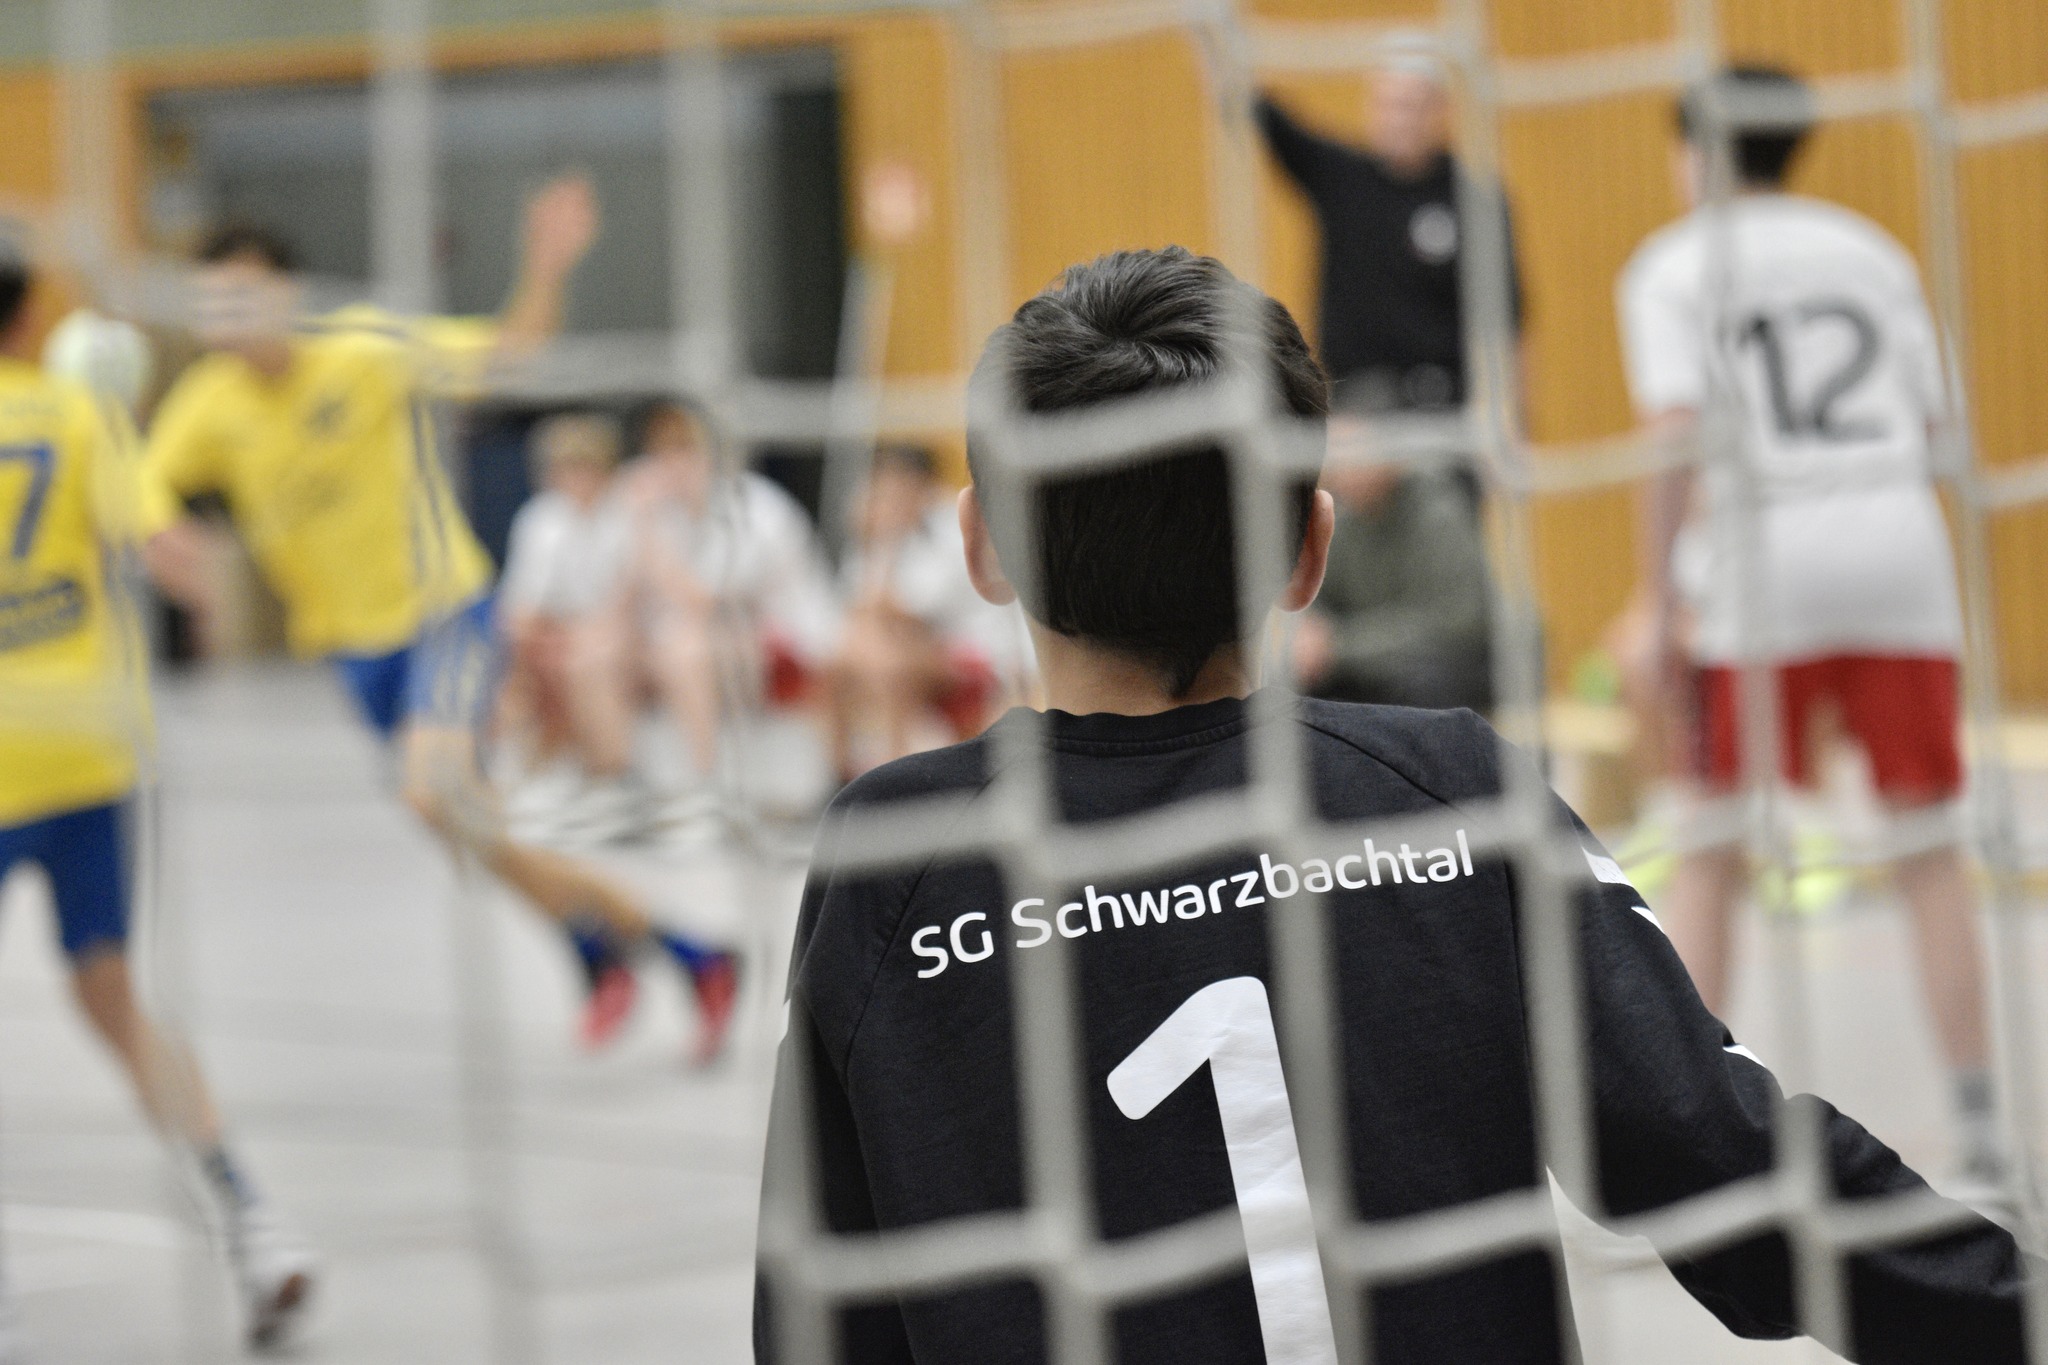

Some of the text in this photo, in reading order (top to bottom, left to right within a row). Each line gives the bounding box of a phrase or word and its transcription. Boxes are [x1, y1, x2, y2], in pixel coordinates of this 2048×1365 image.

[1732, 297, 1889, 441] 12
[910, 829, 1475, 979] SG Schwarzbachtal
[1107, 976, 1339, 1365] 1
